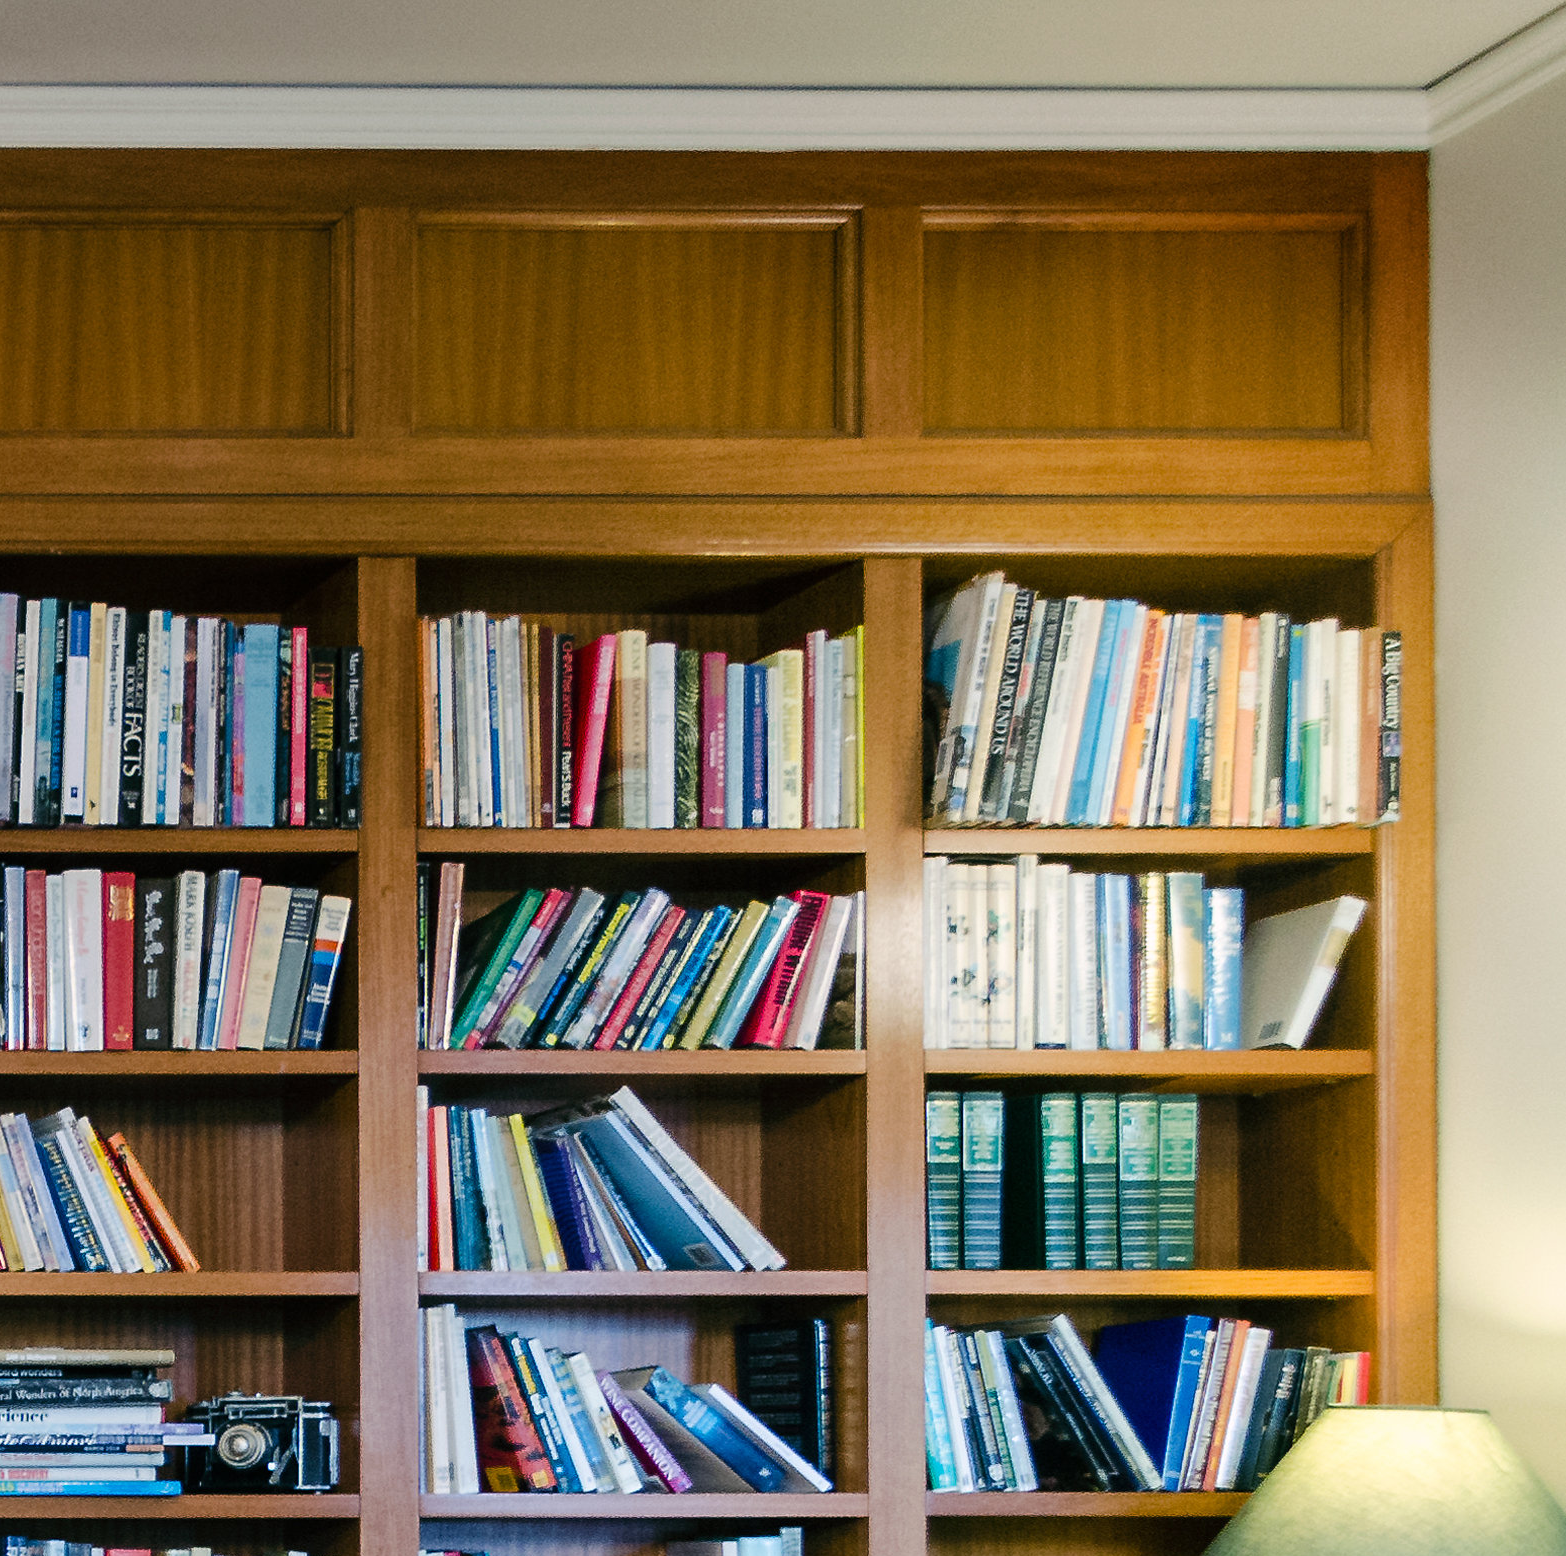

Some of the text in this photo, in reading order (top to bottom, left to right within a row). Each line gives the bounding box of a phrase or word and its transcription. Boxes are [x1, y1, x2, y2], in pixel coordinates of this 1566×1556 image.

[1040, 623, 1058, 660] WORLD
[1205, 647, 1218, 691] NATIONAL
[346, 651, 359, 743] Mary Higgins Clark
[991, 594, 1031, 755] THE WORLD AROUND US
[1029, 662, 1052, 717] REFERENCE
[1132, 618, 1158, 724] INCREDIBLE AUSTRALIA
[1381, 637, 1400, 729] A Big Country
[782, 655, 798, 762] SIDNEY SHELDON
[1204, 694, 1215, 727] PARKS
[122, 712, 142, 777] FACTS
[1202, 755, 1213, 780] WEST
[186, 875, 199, 909] MARK
[183, 912, 198, 951] JOSEPH
[773, 896, 823, 1006] ENQUIRE WITHIN
[1085, 881, 1095, 1036] THE STORY OF THE TIMES
[15, 1385, 58, 1401] Wonders
[72, 1383, 103, 1401] North
[20, 1368, 63, 1378] wonders
[597, 1376, 674, 1481] WINE COMPANION
[7, 1469, 50, 1479] DISCOVERY
